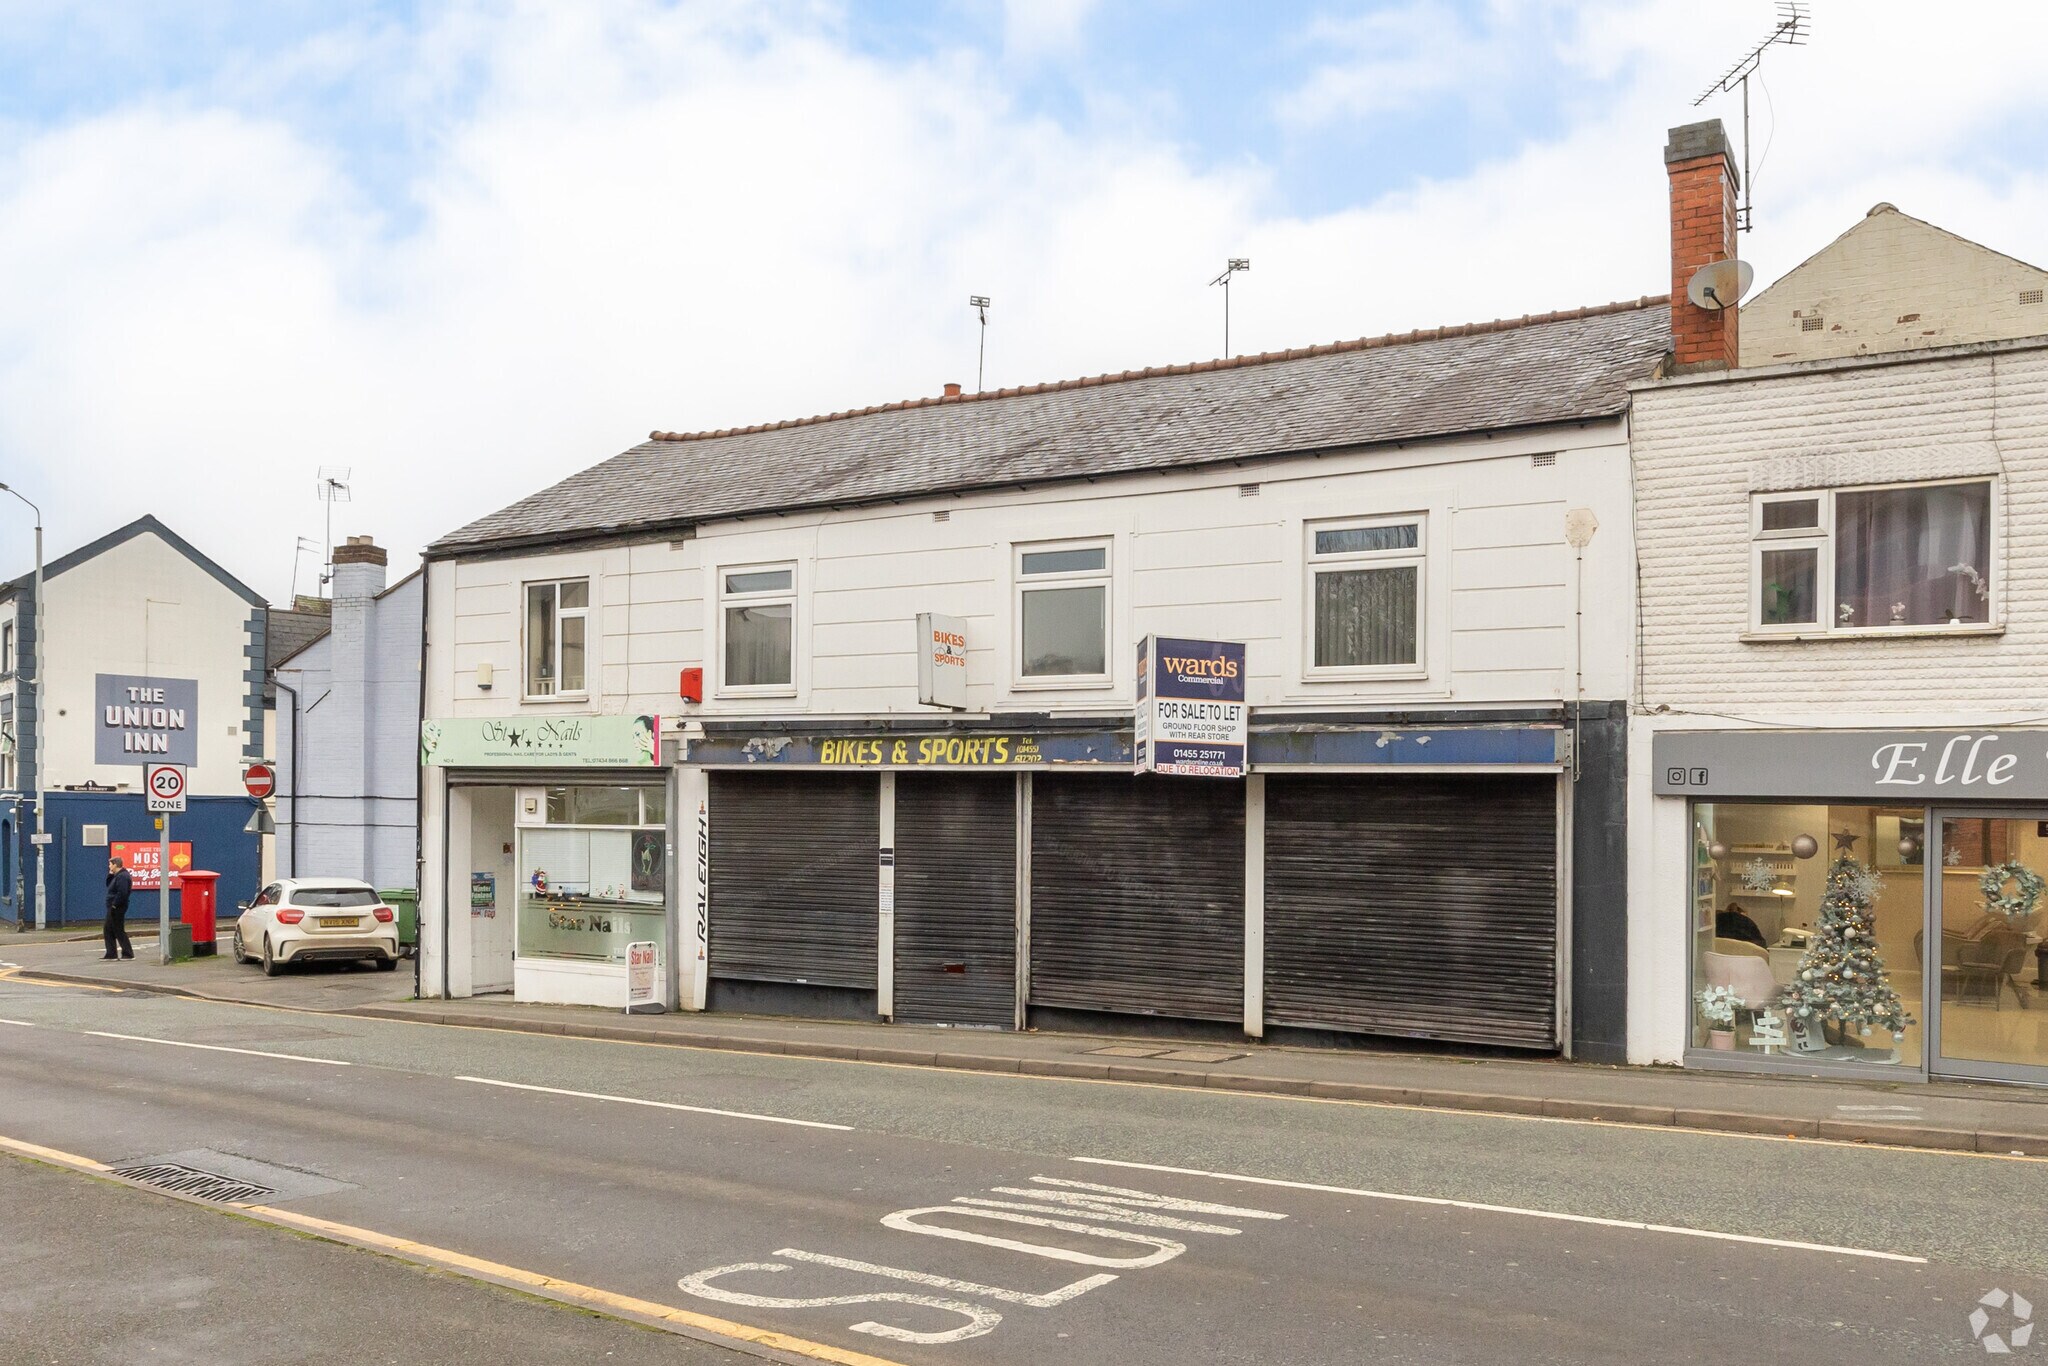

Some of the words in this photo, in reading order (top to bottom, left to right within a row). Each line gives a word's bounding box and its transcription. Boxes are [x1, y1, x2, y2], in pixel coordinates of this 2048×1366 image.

[933, 630, 965, 648] BIKES
[946, 645, 952, 655] &
[934, 653, 965, 667] SPORTS
[1163, 656, 1238, 678] wards
[1178, 675, 1224, 685] Commercial
[126, 687, 165, 704] THE
[105, 705, 185, 730] UNION
[1158, 702, 1178, 719] FOR
[1224, 705, 1241, 721] LET
[537, 719, 583, 742] Nails
[1162, 722, 1192, 731] GROUND
[1194, 723, 1216, 732] FLOOR
[124, 732, 169, 754] INN
[1169, 731, 1186, 739] WITH
[1207, 733, 1230, 741] STORE
[820, 739, 884, 764] BIKES
[891, 739, 909, 764] &
[917, 737, 1009, 764] SPORTS
[1173, 749, 1198, 758] 01455
[1199, 750, 1226, 760] 251771
[1871, 734, 2018, 785] Elle
[1157, 764, 1174, 774] DUE
[1176, 765, 1187, 774] TO
[1188, 766, 1238, 776] RELOCATION
[155, 776, 179, 790] 20
[151, 800, 182, 809] ZONE
[133, 852, 161, 864] MOS
[126, 868, 150, 881] Party
[150, 868, 179, 879] Seon
[697, 817, 707, 943] RALEIGH
[548, 912, 585, 931] Star
[589, 915, 632, 935] Nails
[631, 951, 642, 965] Star
[642, 950, 654, 964] Nail
[677, 1175, 1290, 1345] SLOW
